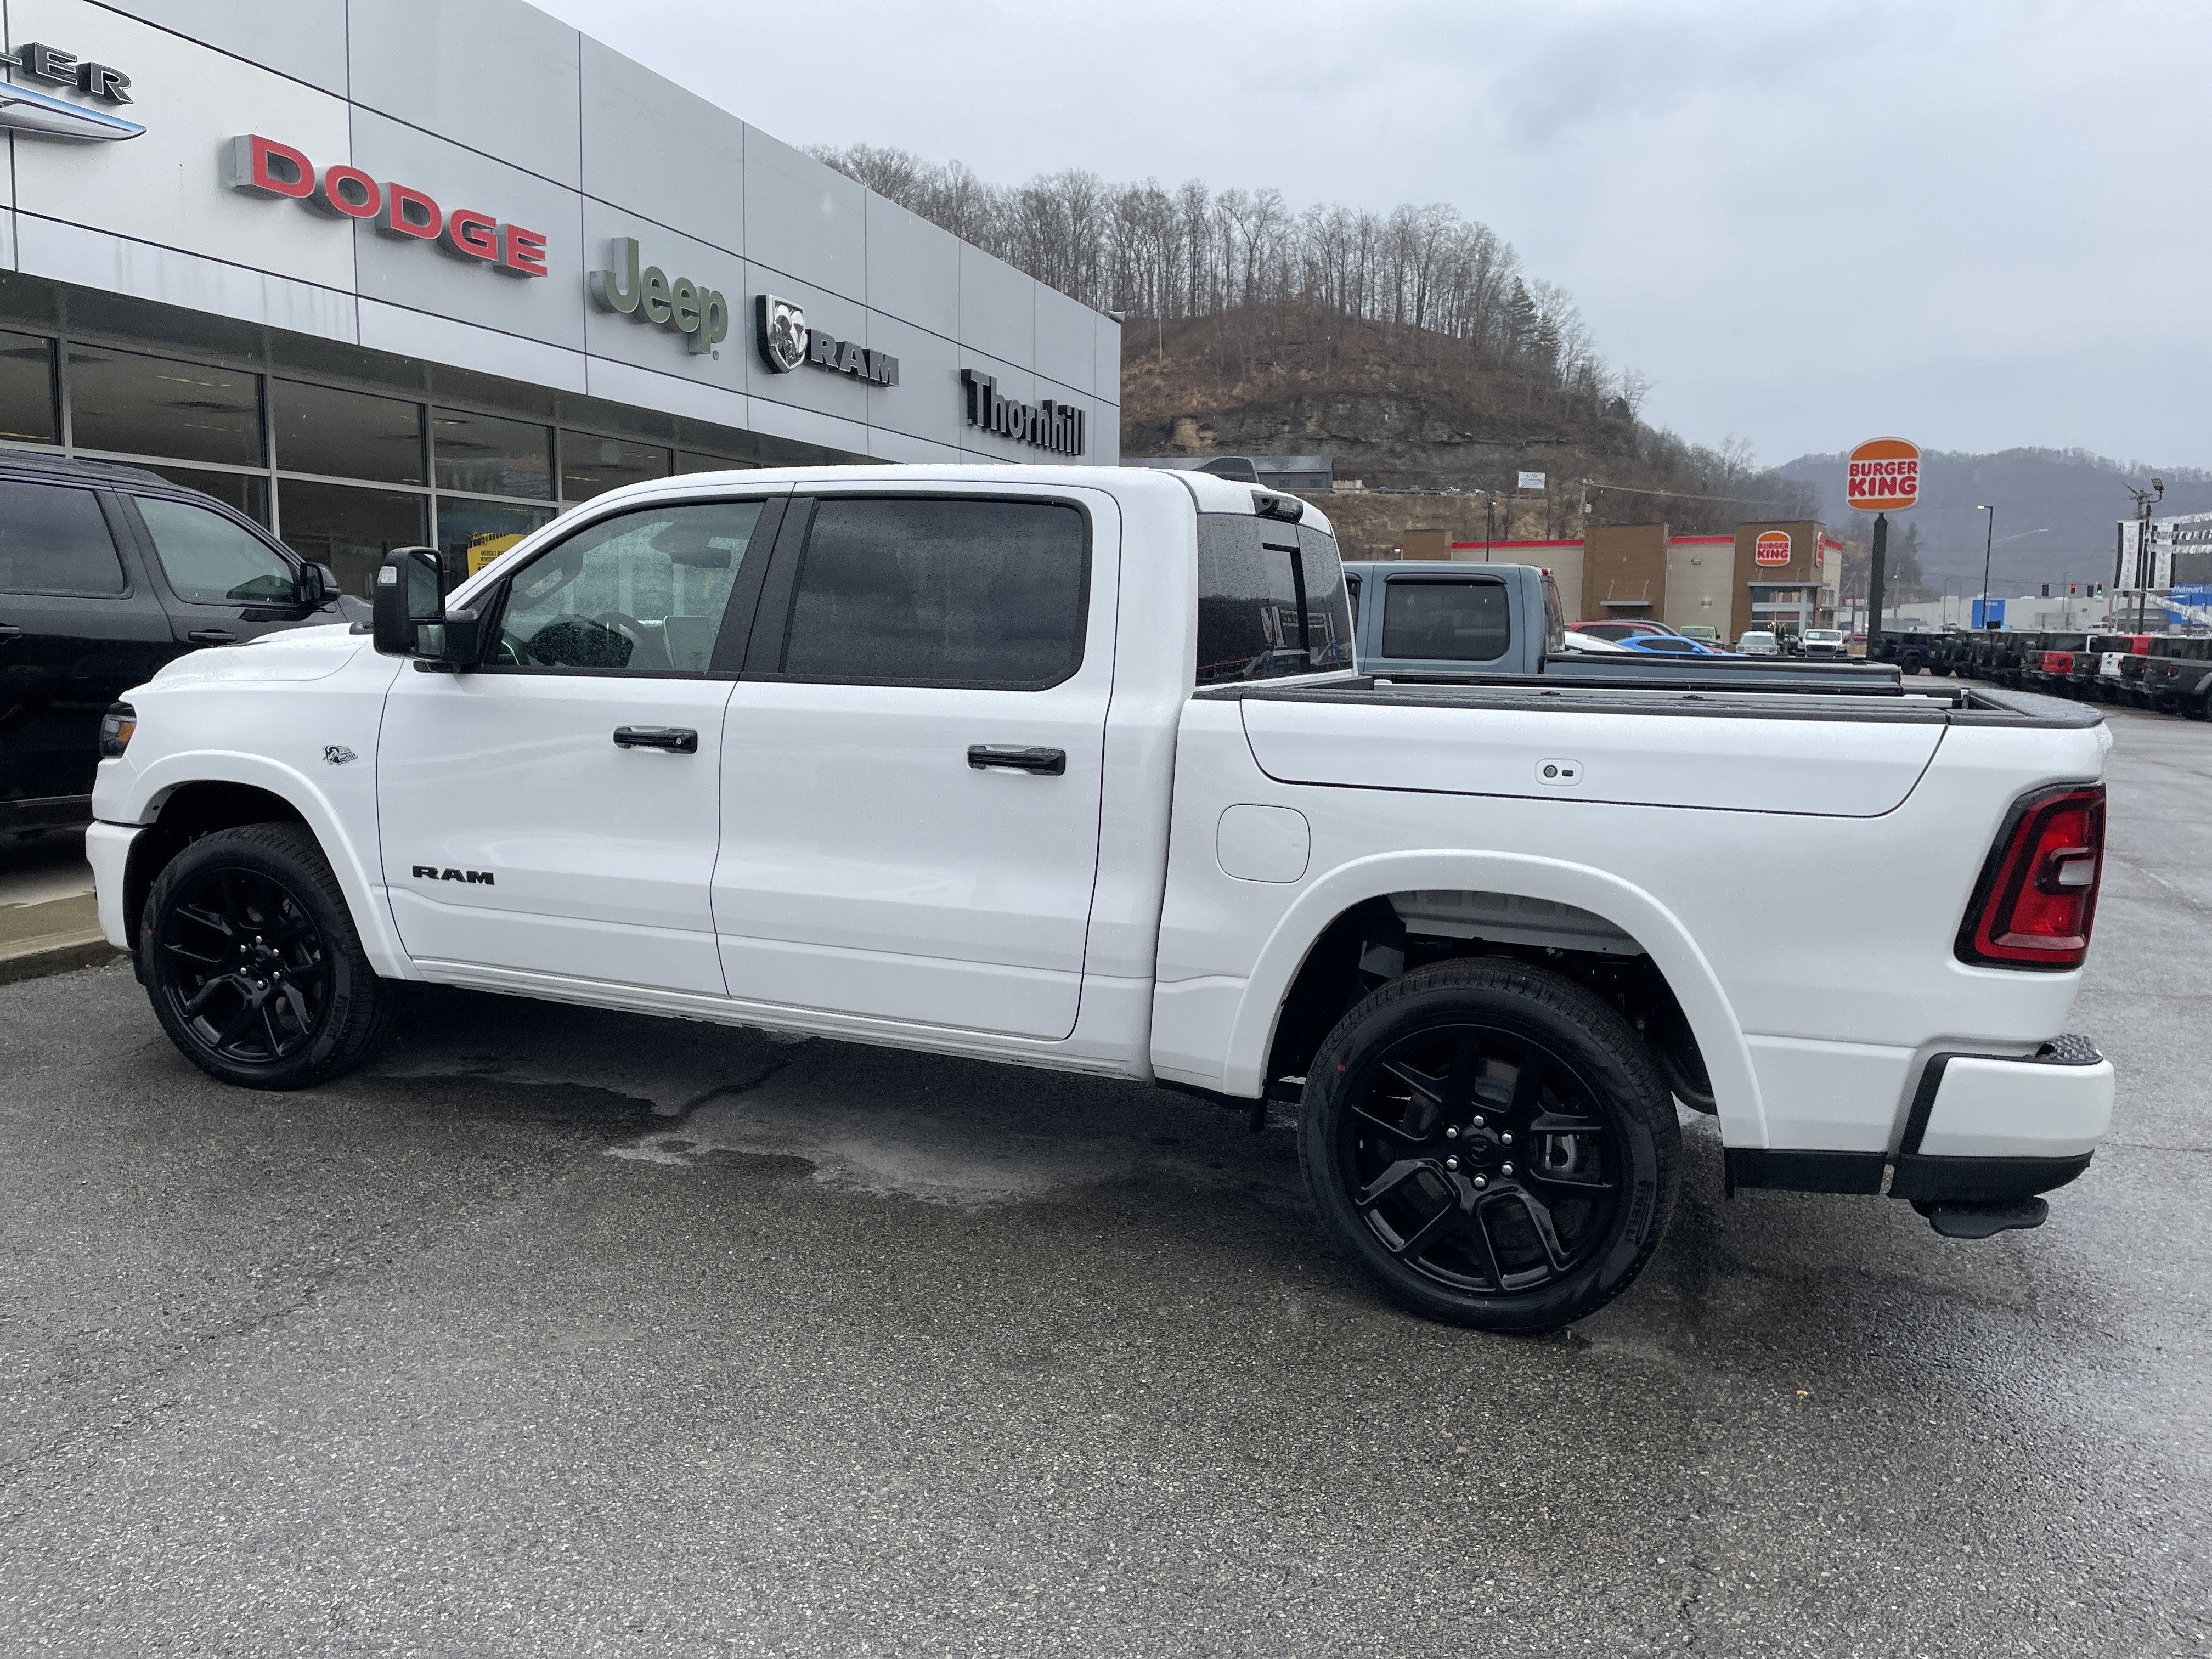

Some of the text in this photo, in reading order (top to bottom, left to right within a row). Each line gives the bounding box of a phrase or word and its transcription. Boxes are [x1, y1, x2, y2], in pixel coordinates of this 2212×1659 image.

[236, 134, 548, 278] DODGE
[591, 236, 729, 354] Jeep
[809, 328, 900, 387] RAM
[961, 368, 1086, 456] Thornhill
[1848, 476, 1917, 497] KING
[1849, 461, 1918, 477] BURGER
[1757, 549, 1788, 559] KING
[412, 865, 495, 885] RAM
